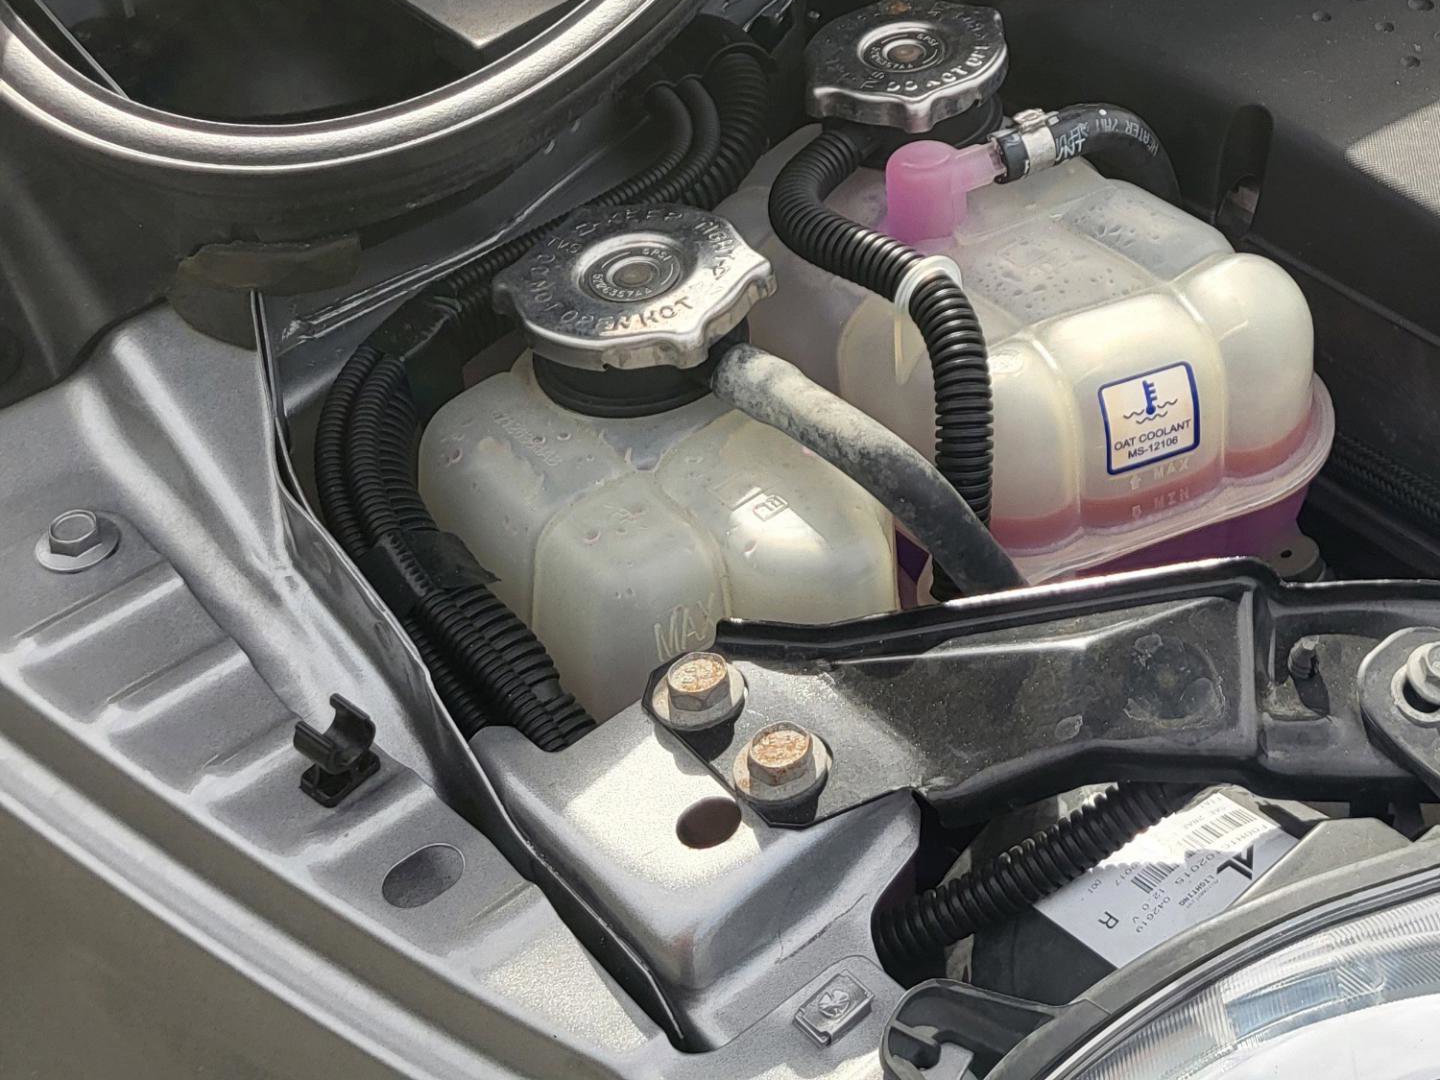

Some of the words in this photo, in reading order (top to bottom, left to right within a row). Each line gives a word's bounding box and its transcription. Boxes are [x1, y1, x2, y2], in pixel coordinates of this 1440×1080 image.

[1113, 436, 1137, 452] OAT
[1138, 418, 1192, 444] COOLANT
[1127, 436, 1179, 460] MS-12106
[1153, 458, 1190, 480] MAX
[1153, 487, 1190, 510] MIN
[1178, 873, 1215, 906] LIGHTING
[1097, 910, 1119, 931] R
